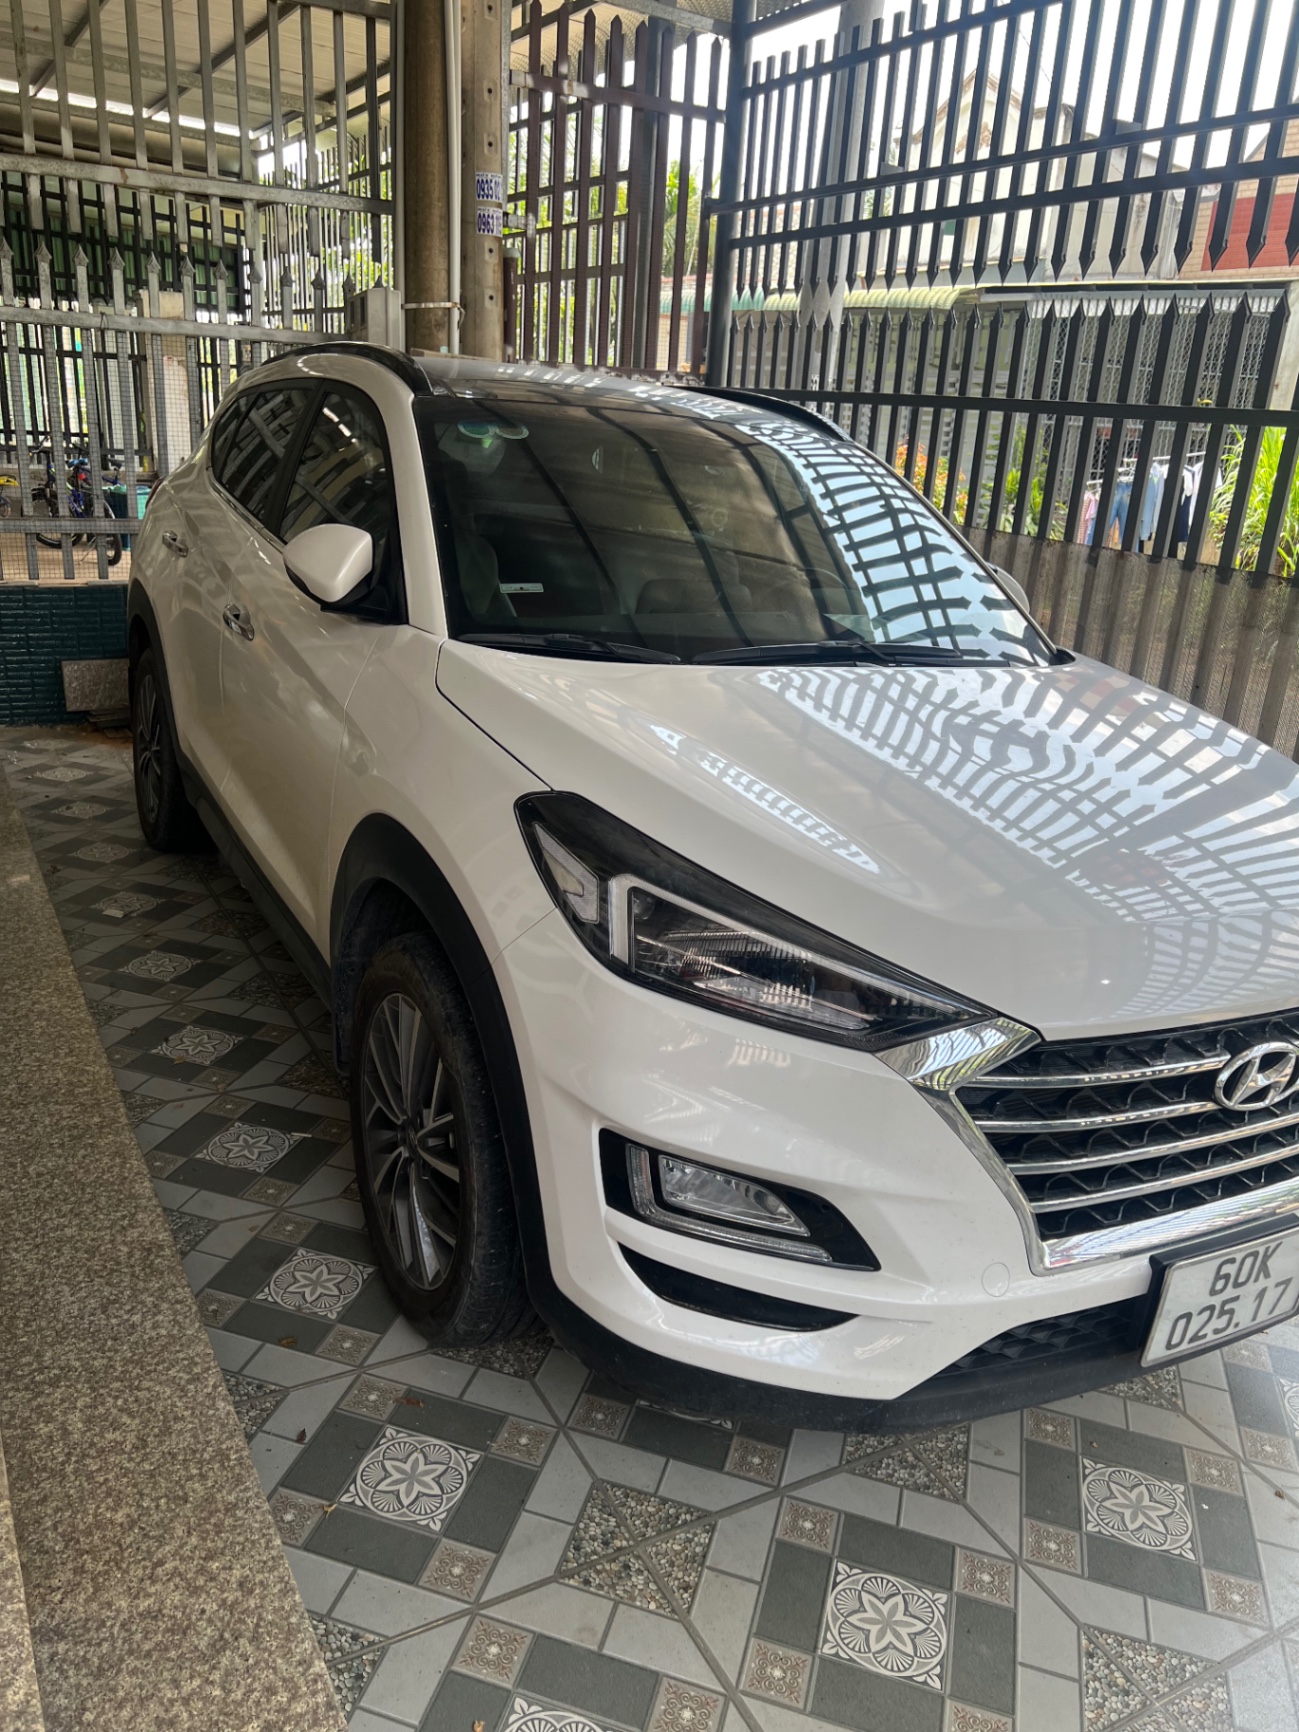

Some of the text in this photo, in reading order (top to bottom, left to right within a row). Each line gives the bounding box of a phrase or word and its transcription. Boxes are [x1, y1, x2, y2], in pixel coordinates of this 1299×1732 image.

[476, 178, 493, 199] 0935
[477, 212, 494, 234] 0963
[1208, 1241, 1284, 1297] 60K
[1165, 1277, 1294, 1350] 025.17
